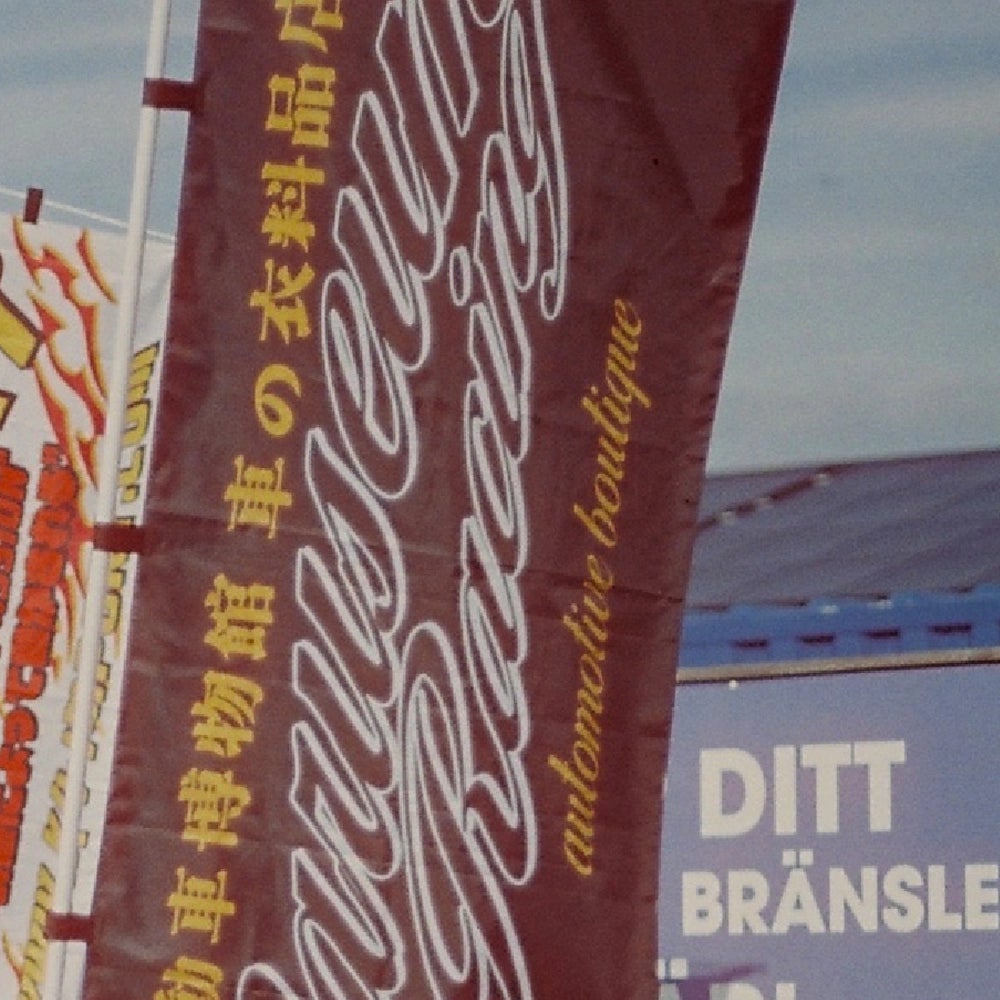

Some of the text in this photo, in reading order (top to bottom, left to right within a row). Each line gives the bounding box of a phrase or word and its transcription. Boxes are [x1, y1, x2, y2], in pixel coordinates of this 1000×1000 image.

[547, 297, 652, 877] automotive boutique
[699, 741, 906, 838] DITT
[681, 848, 1000, 936] BRÄNSLE
